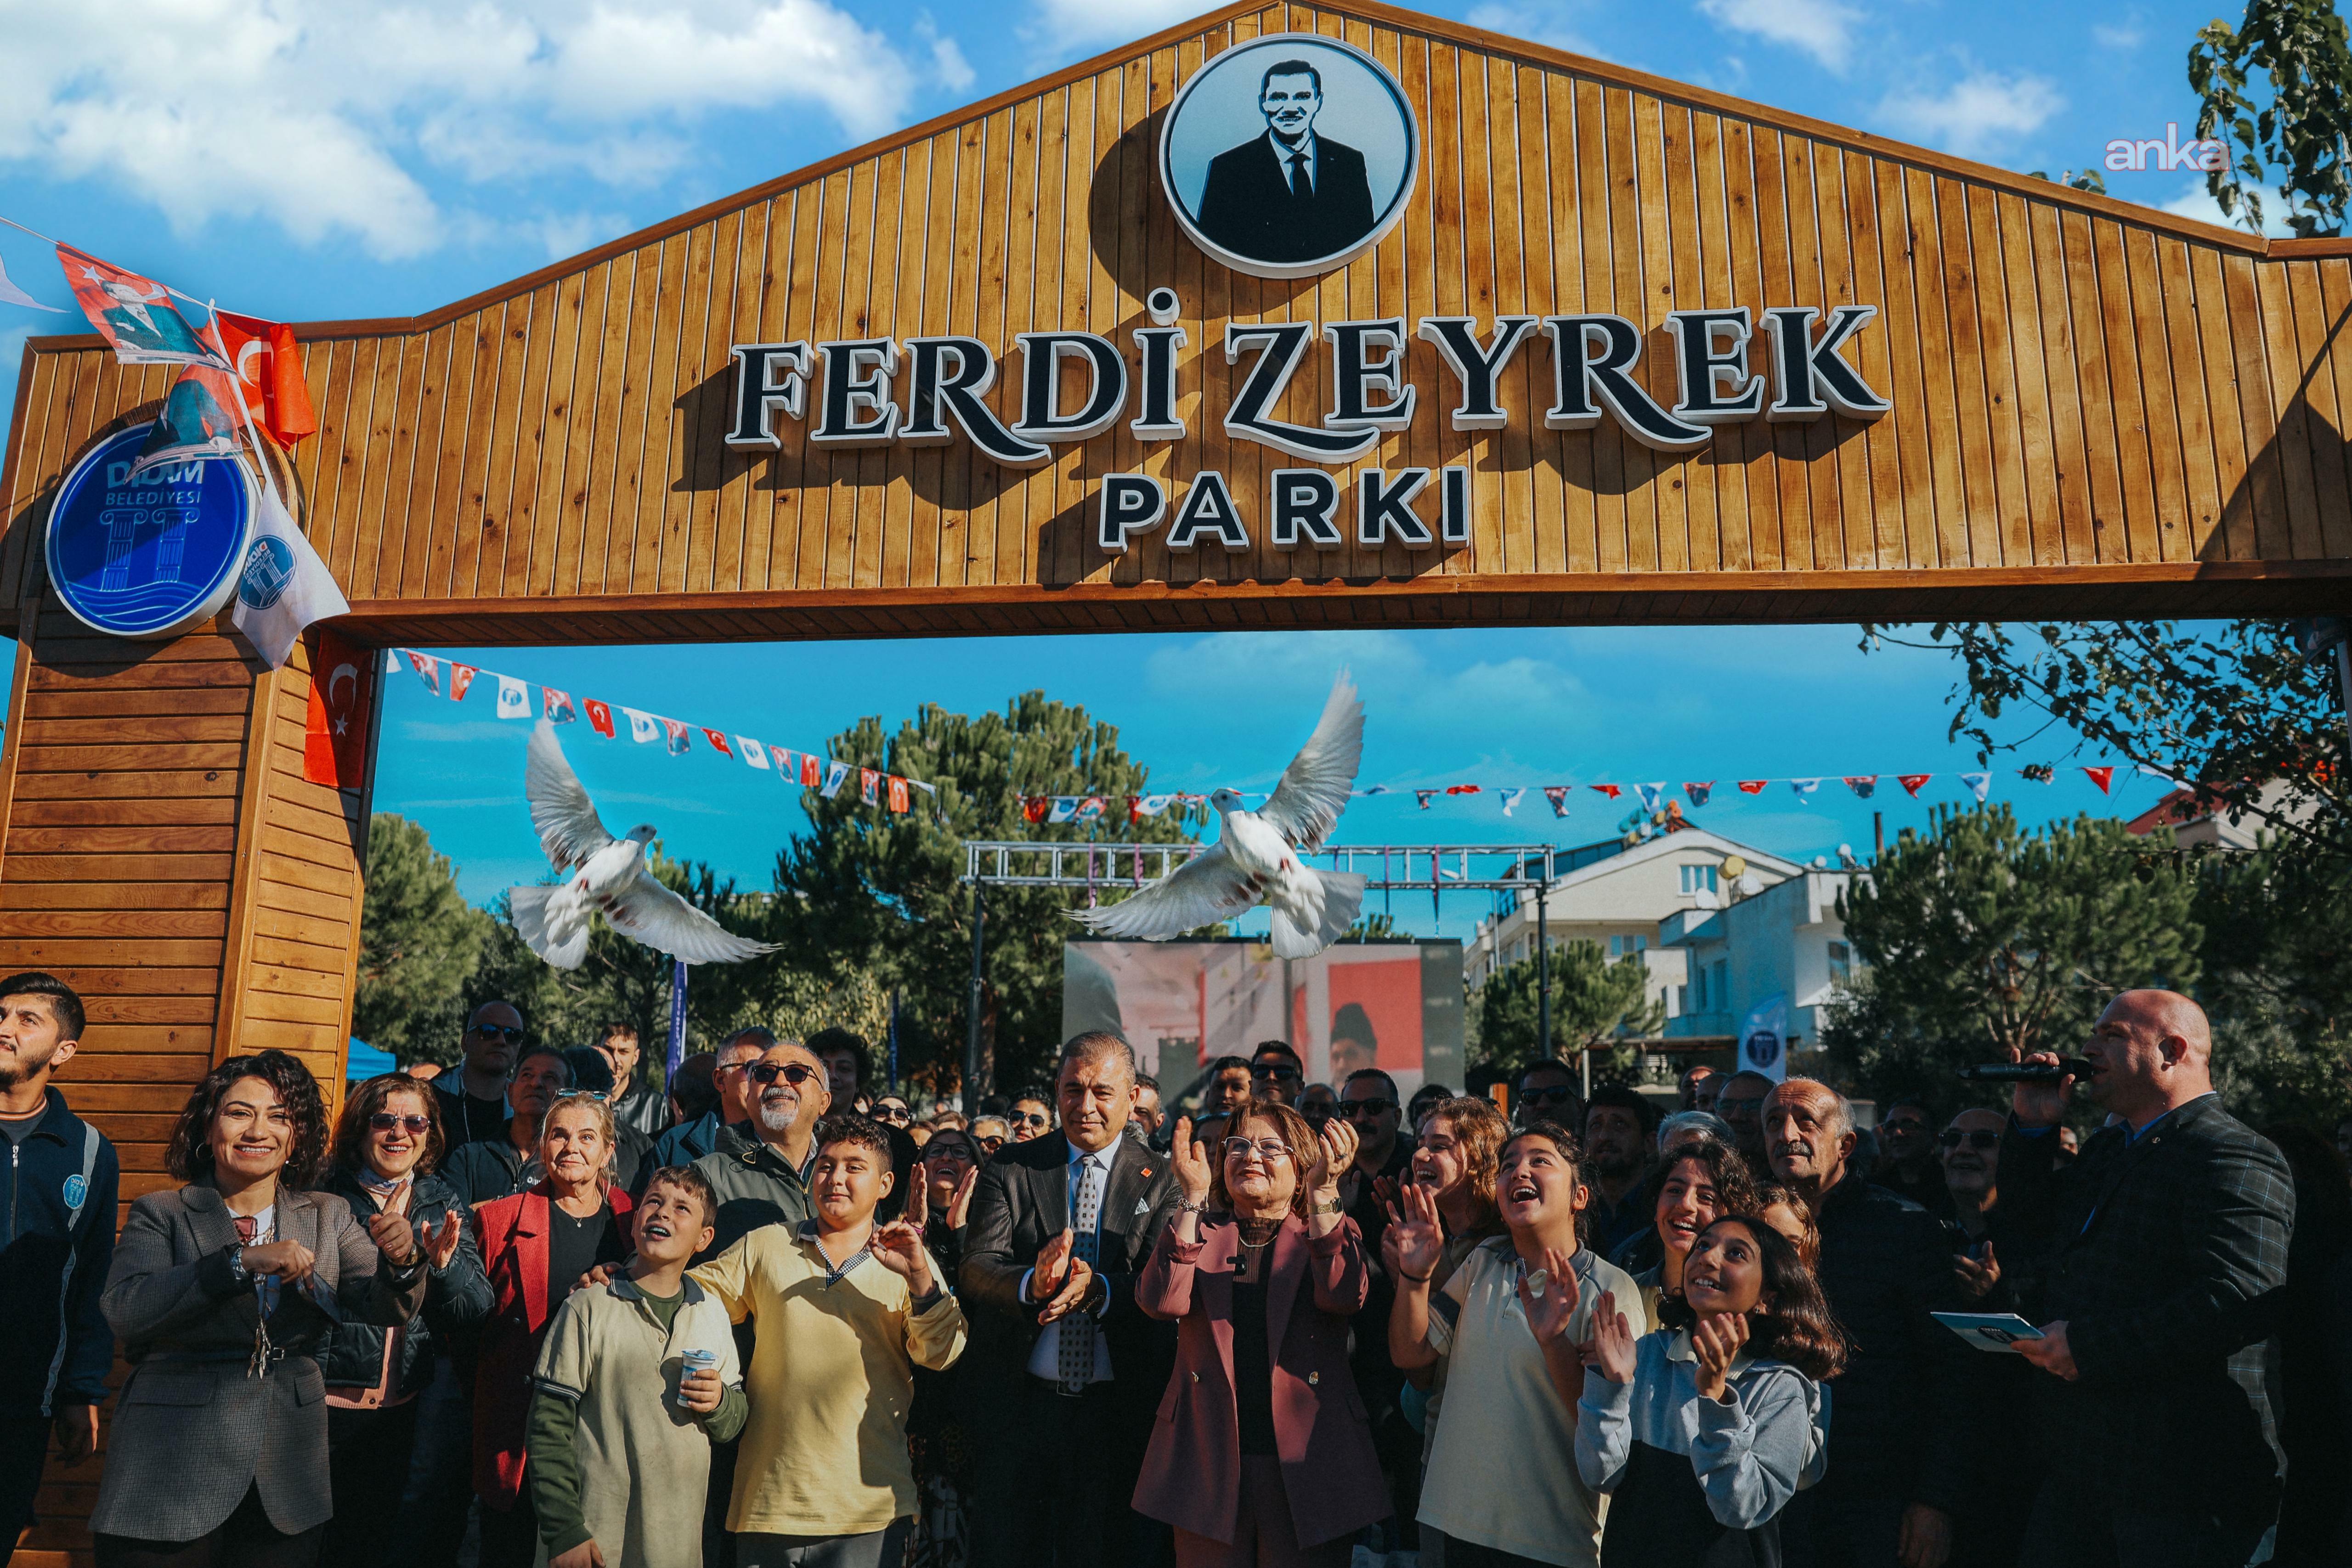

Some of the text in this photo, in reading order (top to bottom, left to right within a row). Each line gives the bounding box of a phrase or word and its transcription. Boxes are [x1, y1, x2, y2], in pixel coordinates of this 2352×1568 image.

[724, 287, 1892, 469] FERDİ ZEYREK
[1099, 465, 1470, 554] PARKI
